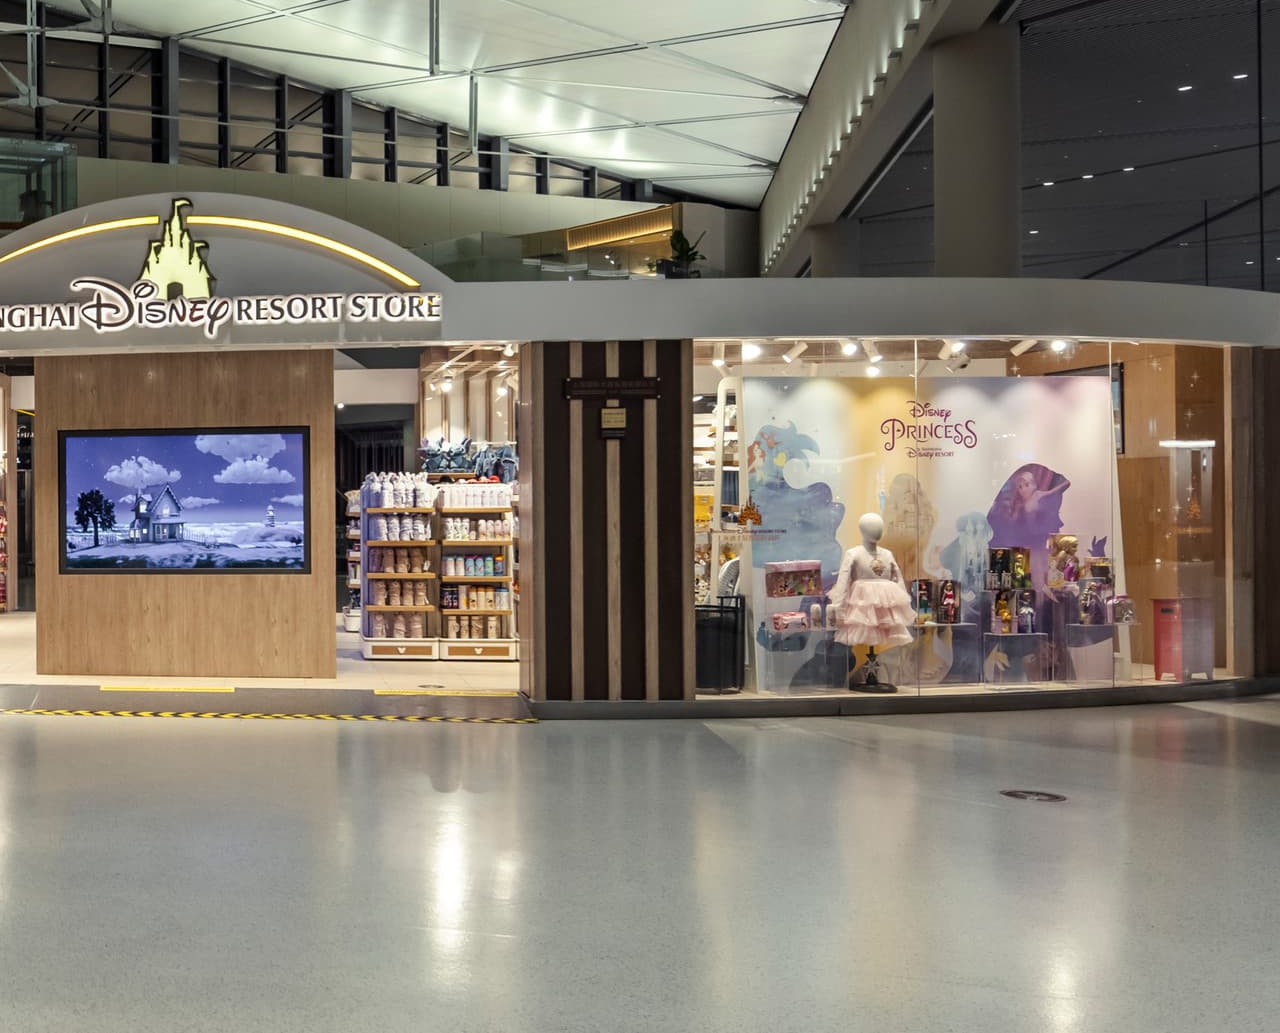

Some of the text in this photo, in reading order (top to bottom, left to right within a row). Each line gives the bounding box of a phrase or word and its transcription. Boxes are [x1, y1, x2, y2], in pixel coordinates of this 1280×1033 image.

[72, 279, 231, 336] Disney
[236, 295, 344, 322] RESORT
[350, 294, 441, 320] STORE
[906, 400, 952, 422] Disney
[880, 418, 978, 452] PRINCESS
